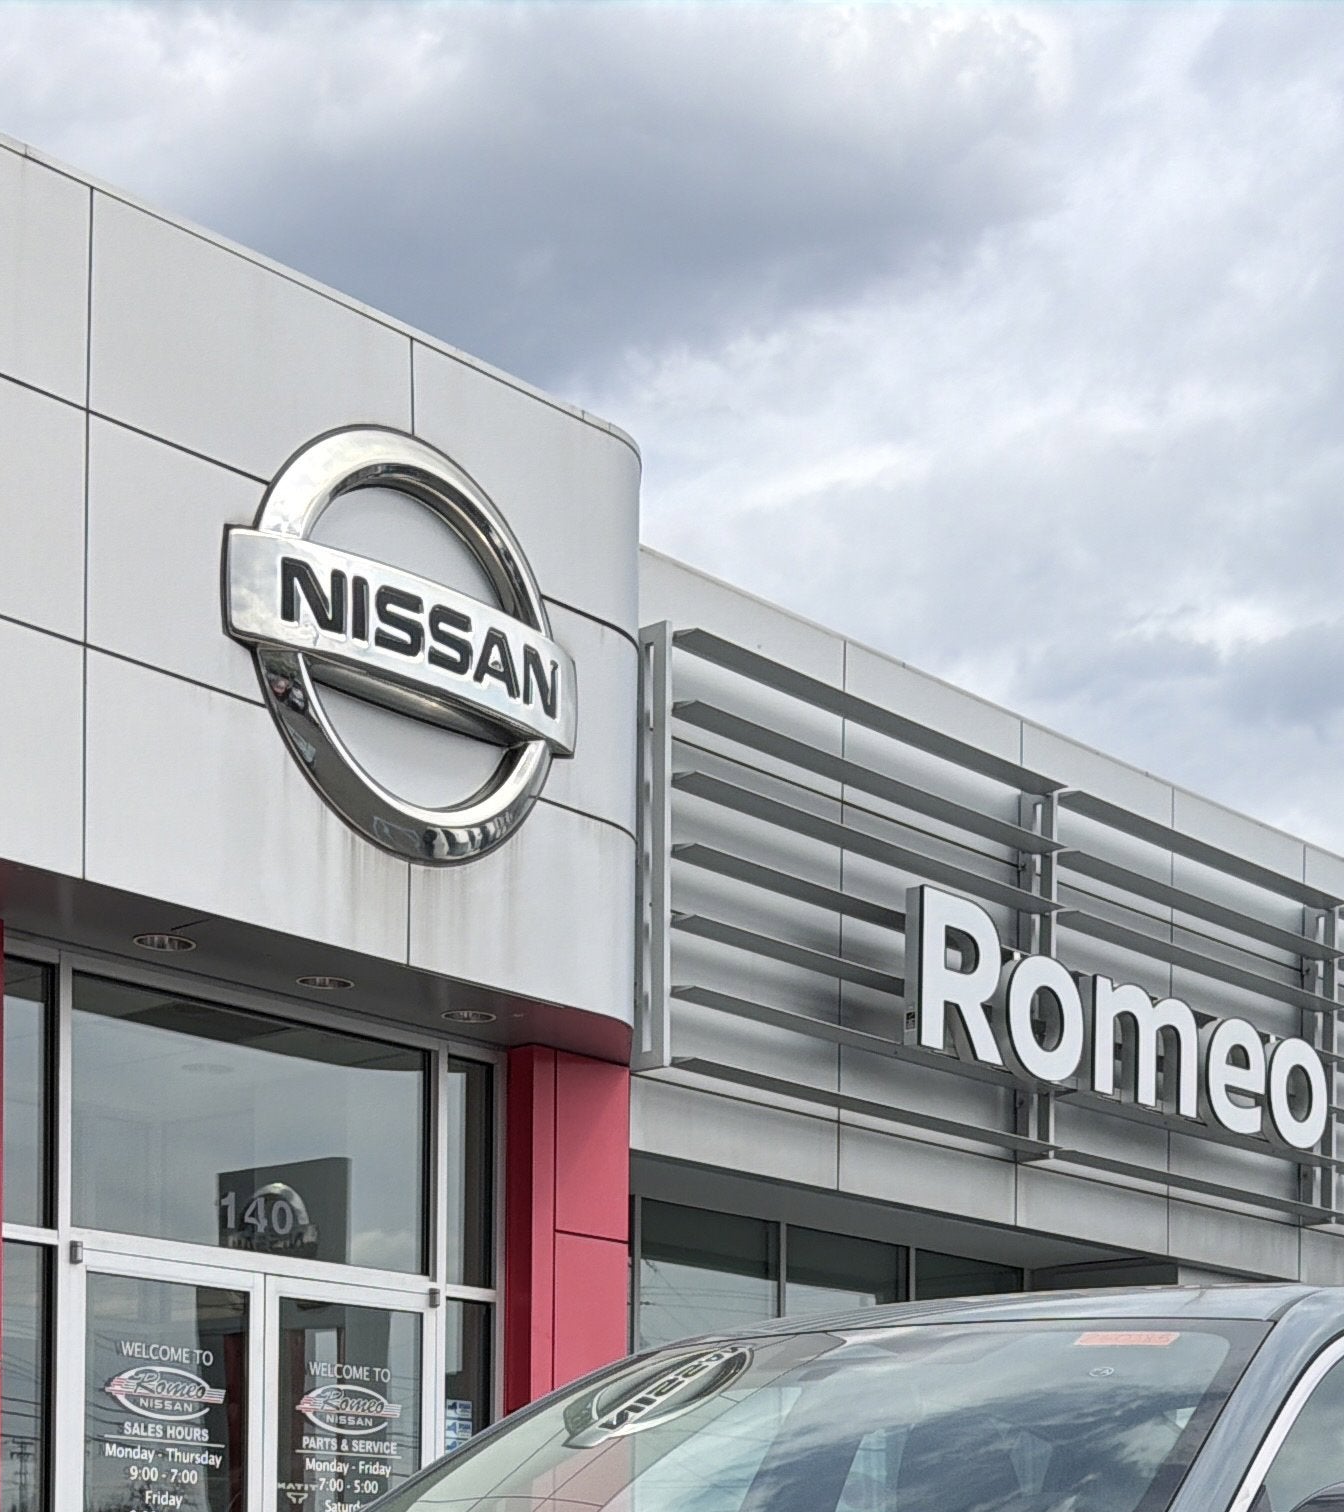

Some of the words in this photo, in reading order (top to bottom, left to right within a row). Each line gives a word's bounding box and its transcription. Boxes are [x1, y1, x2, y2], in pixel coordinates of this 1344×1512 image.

[280, 556, 560, 721] NISSAN
[916, 884, 1328, 1149] Romeo
[220, 1191, 294, 1235] 140
[121, 1340, 191, 1364] WELCOME
[194, 1349, 214, 1366] TO
[308, 1361, 370, 1381] WELCOME
[373, 1367, 391, 1383] TO
[129, 1370, 206, 1399] Romeo
[138, 1397, 193, 1412] NISSAN
[318, 1387, 385, 1414] Romeo
[123, 1421, 163, 1438] SALES
[166, 1425, 209, 1441] HOURS
[325, 1414, 373, 1427] NISSAN
[104, 1443, 155, 1462] Monday
[165, 1447, 222, 1469] Thursday
[302, 1436, 337, 1451] PARTS
[340, 1439, 349, 1452] &
[352, 1440, 397, 1455] SERVICE
[129, 1465, 158, 1482] 9:00
[170, 1469, 198, 1484] 7:00
[305, 1458, 349, 1475] Monday
[358, 1461, 392, 1478] Friday
[318, 1477, 344, 1492] 7:00
[353, 1480, 379, 1494] 5:00
[144, 1490, 183, 1509] Friday
